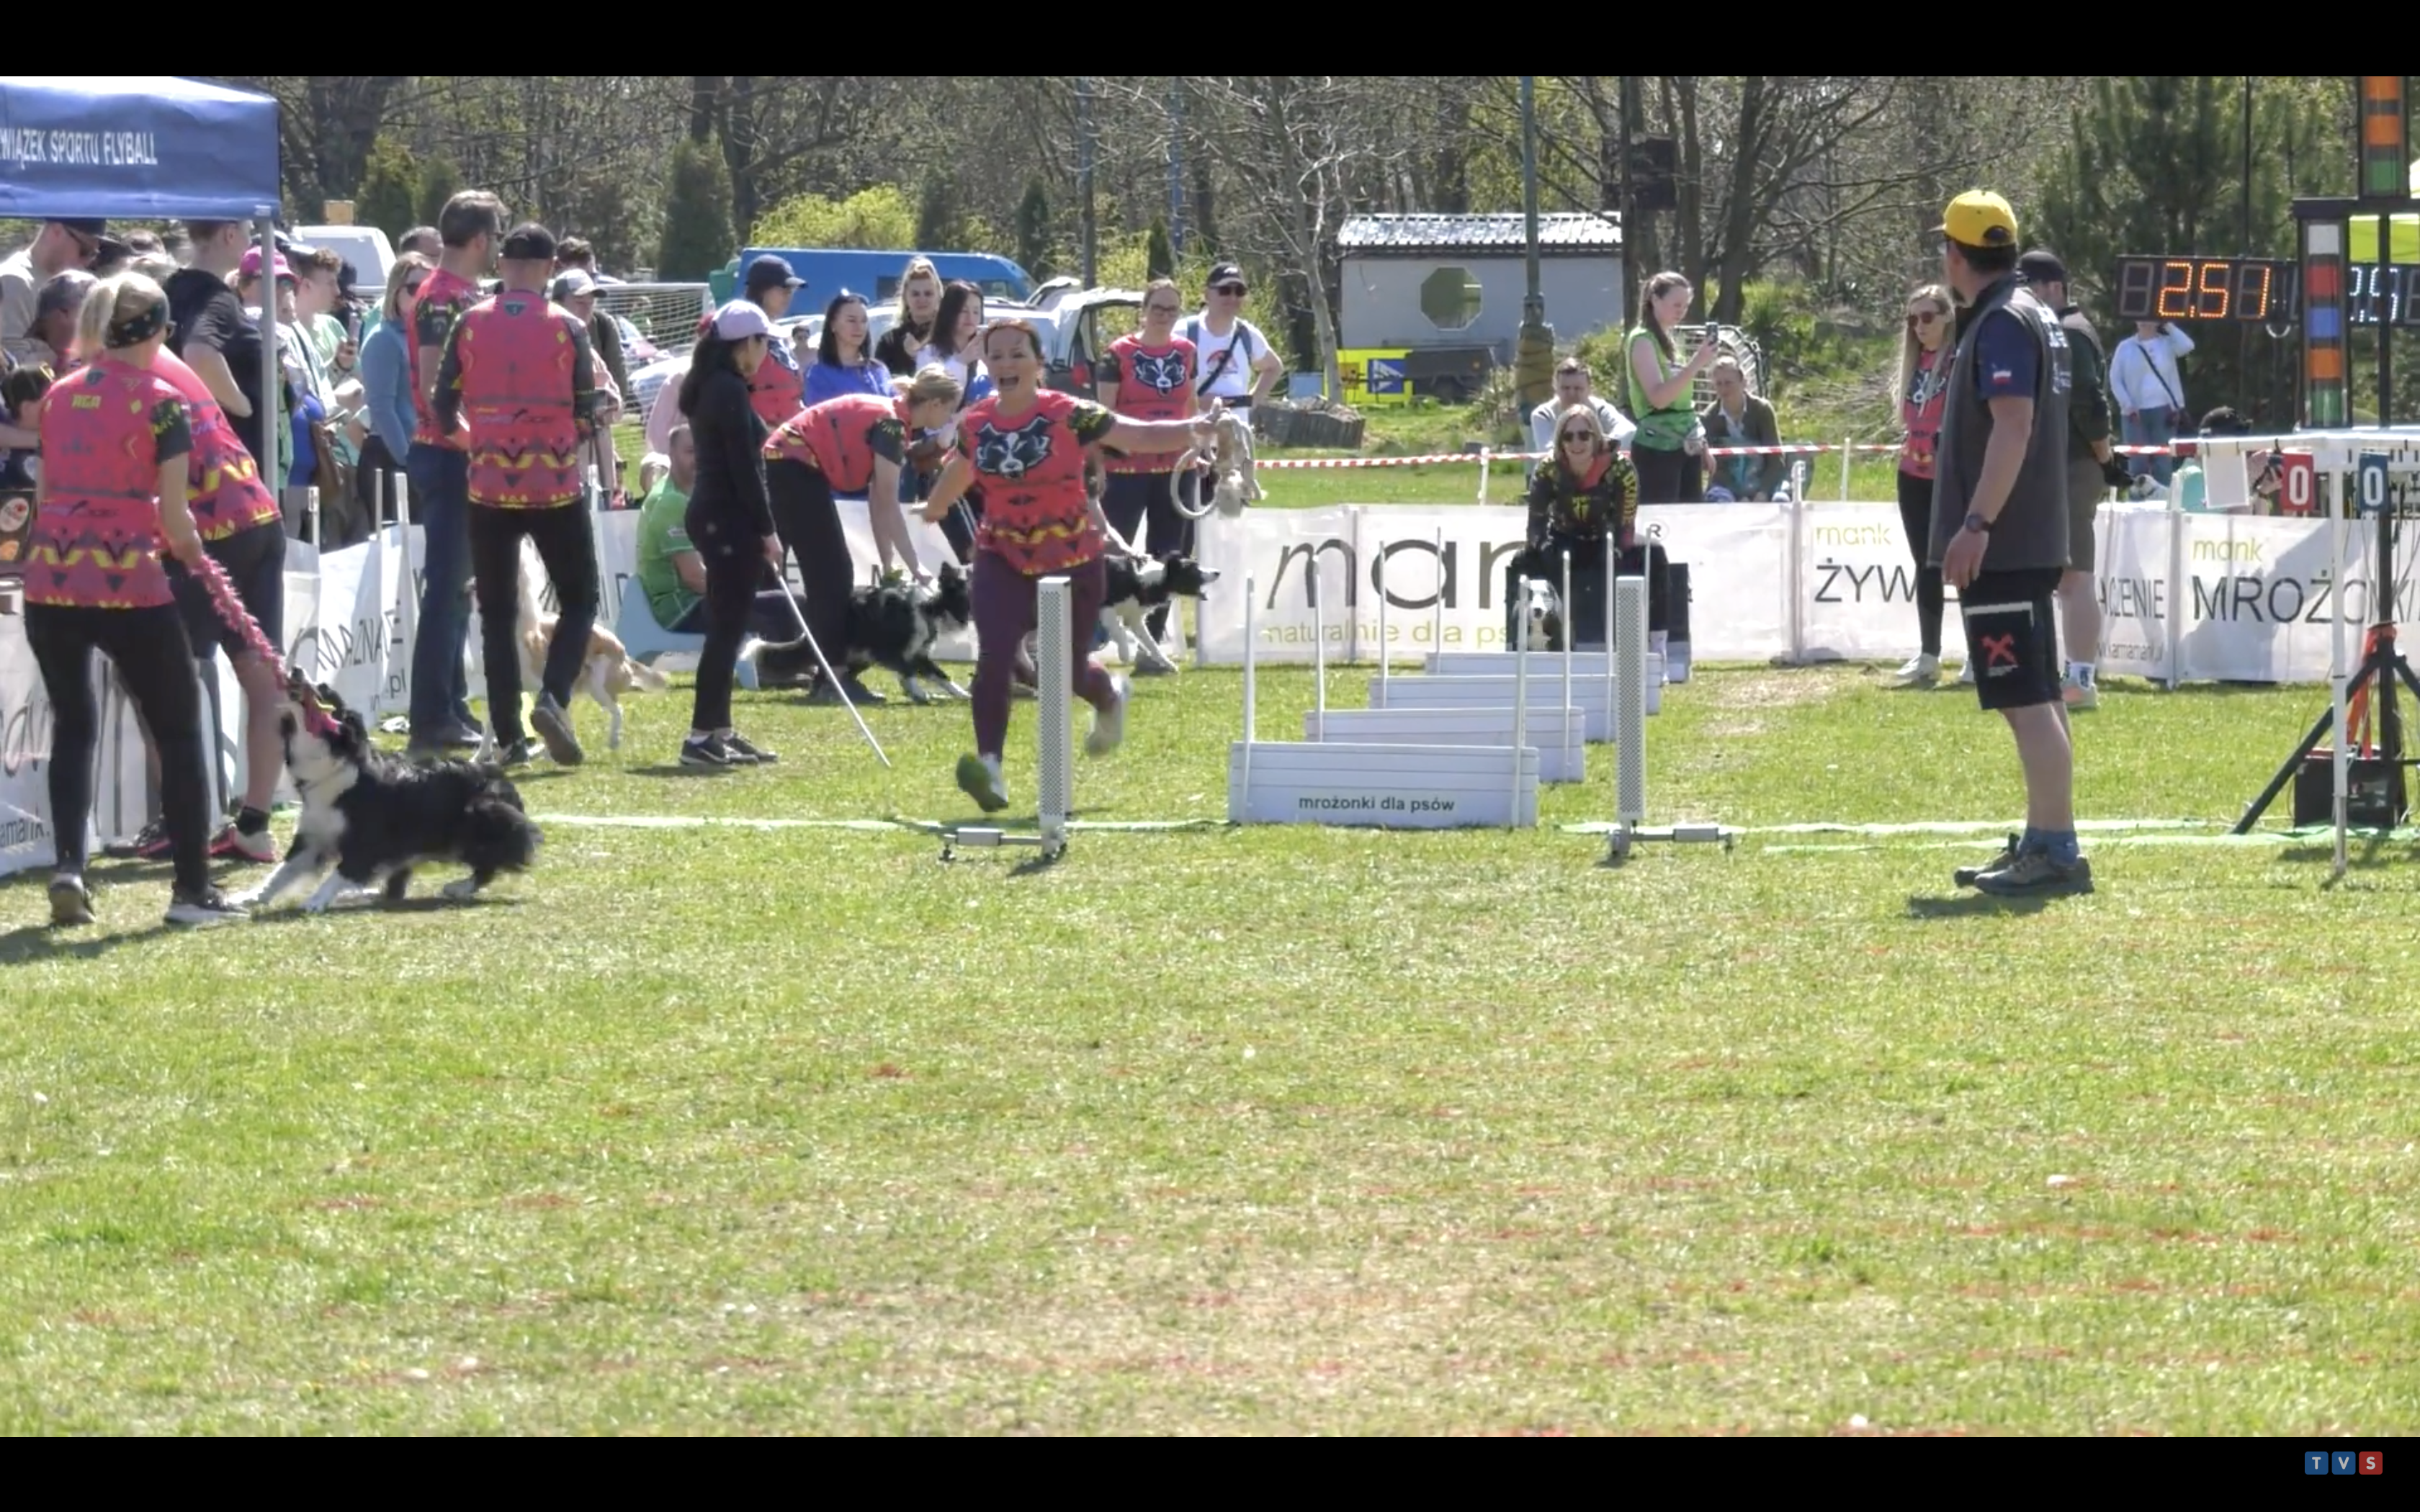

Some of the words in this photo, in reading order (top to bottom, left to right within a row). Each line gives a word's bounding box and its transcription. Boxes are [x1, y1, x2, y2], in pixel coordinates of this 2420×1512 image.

[0, 127, 47, 170] WIĄZEK
[50, 129, 99, 164] SPORTU
[103, 130, 158, 165] FLYBALL
[2289, 465, 2309, 505] 0
[2363, 466, 2383, 506] 0
[1816, 523, 1892, 546] mank
[2193, 538, 2263, 562] mank
[1267, 539, 1526, 609] man
[1814, 557, 1917, 603] ŻYW
[1299, 796, 1375, 809] mrożonki
[1380, 796, 1405, 811] dla
[1410, 796, 1455, 814] psów
